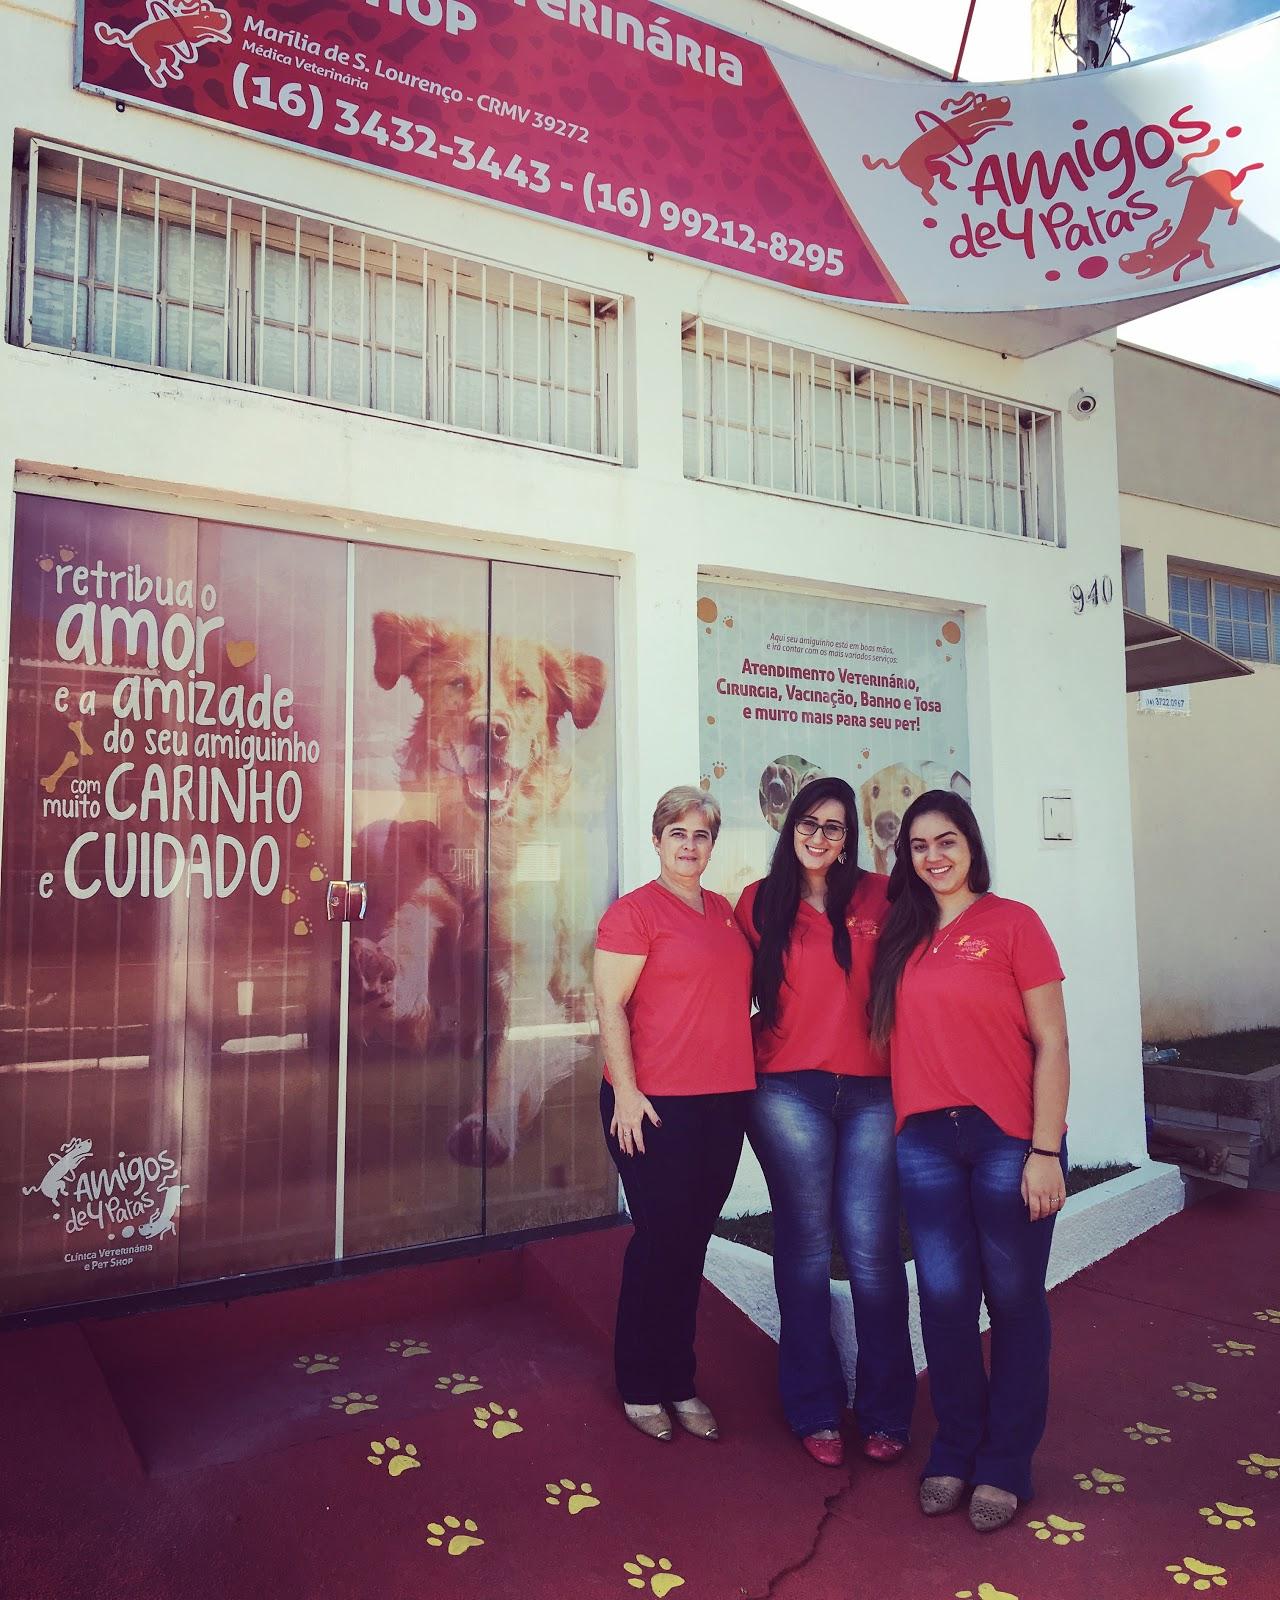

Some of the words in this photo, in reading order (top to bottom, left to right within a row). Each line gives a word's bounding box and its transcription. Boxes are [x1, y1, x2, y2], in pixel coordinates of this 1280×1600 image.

[242, 39, 292, 66] Médica
[295, 56, 369, 91] Veterinária
[514, 0, 743, 87] erinária
[243, 15, 321, 56] Marília
[324, 45, 350, 66] de
[352, 53, 370, 73] S.
[374, 59, 463, 103] Lourenço
[476, 94, 531, 123] CRMV
[531, 111, 589, 144] 39272
[233, 61, 324, 130] (16)
[334, 98, 551, 194] 3432-3443
[583, 171, 651, 229] (16)
[659, 201, 844, 277] 99212-8295
[968, 104, 1212, 206] Amigos
[1039, 190, 1159, 251] Patas
[55, 559, 193, 610] retribua
[201, 583, 217, 612] o
[55, 601, 225, 674] amor
[770, 632, 786, 643] Aqui
[799, 636, 835, 648] amiguinho
[783, 645, 804, 653] contar
[804, 647, 819, 655] com
[54, 686, 70, 713] e
[79, 690, 96, 717] a
[112, 670, 294, 731] amizade
[716, 677, 783, 702] Cirurgia,
[785, 684, 858, 709] Vacinação,
[860, 691, 902, 710] Banho
[903, 698, 912, 710] e
[914, 696, 942, 713] Tosa
[741, 658, 836, 683] Atendimento
[838, 667, 920, 692] Veterinário,
[103, 719, 134, 754] do
[144, 728, 188, 756] seu
[194, 729, 320, 770] amiguinho
[742, 706, 752, 719] e
[755, 707, 798, 723] muito
[801, 711, 833, 725] mais
[836, 714, 867, 728] para
[869, 716, 892, 730] seu
[894, 716, 921, 732] pet!
[43, 795, 100, 819] muito
[71, 777, 101, 795] com
[105, 762, 303, 824] CARINHO
[39, 871, 54, 899] e
[64, 831, 281, 900] CUIDADO
[73, 1150, 176, 1203] Amigos
[105, 1192, 155, 1224] Patas
[64, 1252, 97, 1263] Clínica
[98, 1244, 153, 1258] Veterinária
[84, 1263, 91, 1271] e
